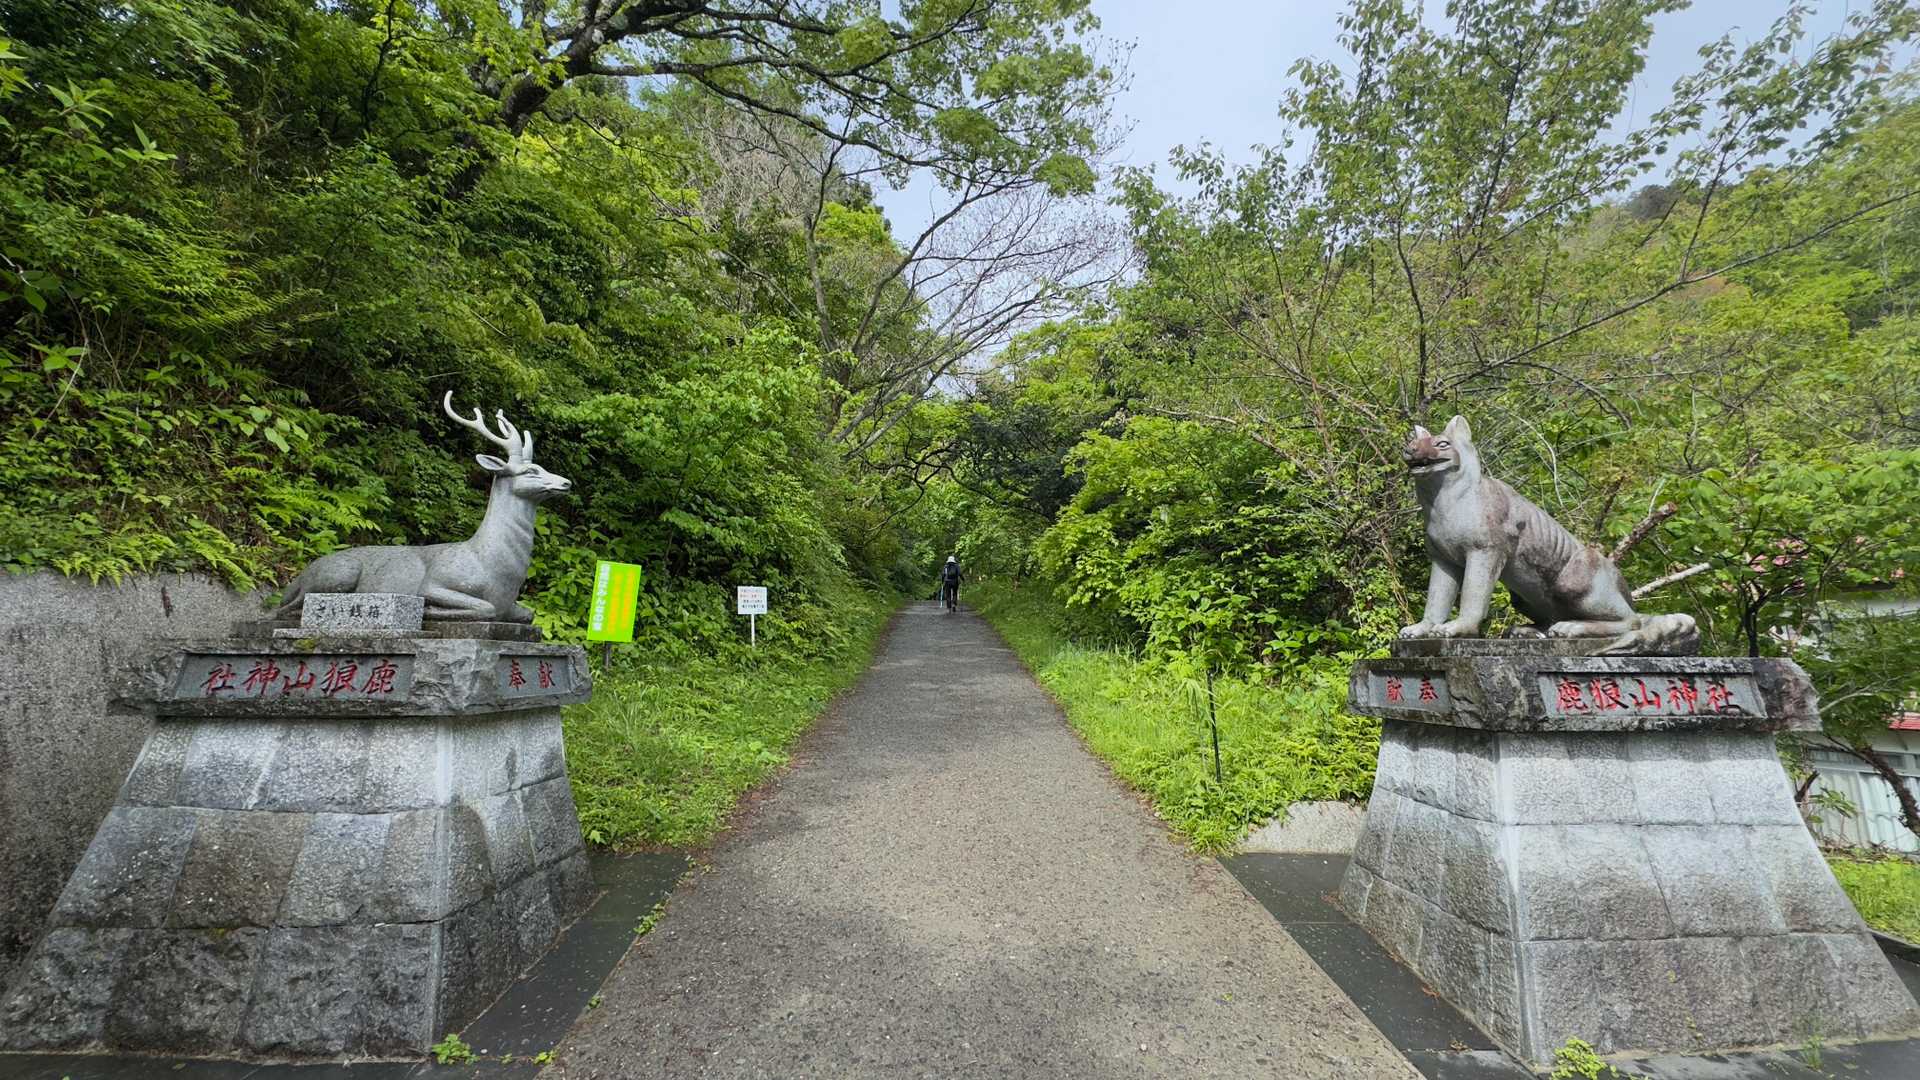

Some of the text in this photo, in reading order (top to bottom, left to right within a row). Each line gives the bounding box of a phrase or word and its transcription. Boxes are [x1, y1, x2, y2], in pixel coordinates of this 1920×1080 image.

[1556, 677, 1741, 714] 鹿狼山神社
